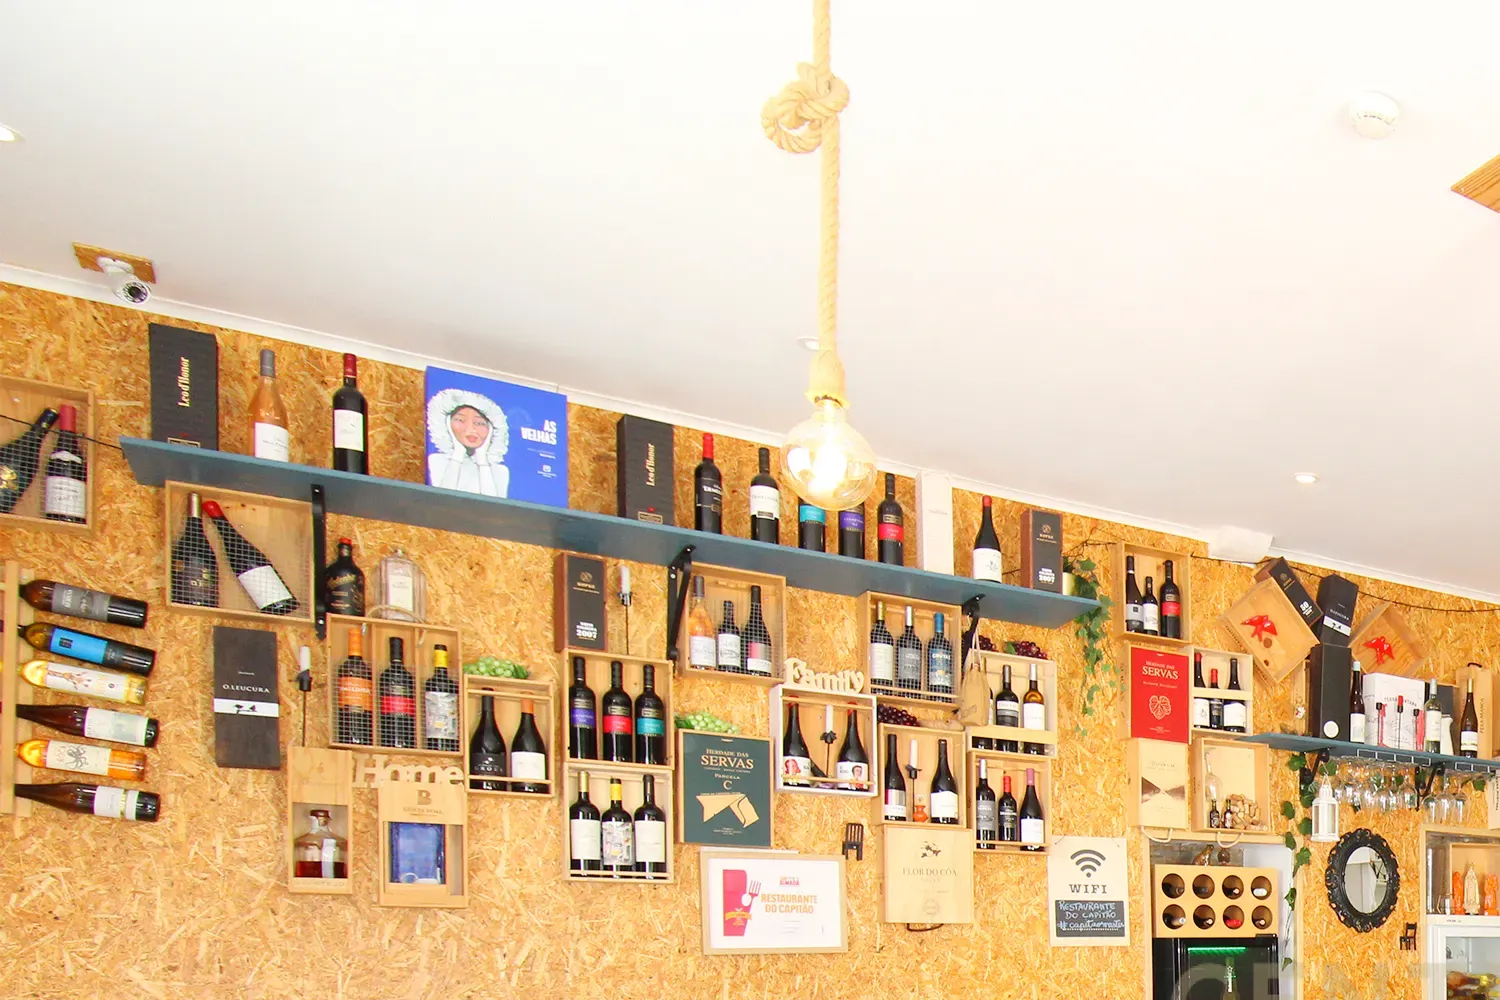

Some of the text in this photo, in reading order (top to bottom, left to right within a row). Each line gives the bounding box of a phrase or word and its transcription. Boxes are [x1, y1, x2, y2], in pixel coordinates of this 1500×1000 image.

[543, 419, 557, 433] AS
[520, 427, 557, 446] VELHAS
[1038, 574, 1055, 583] 2007
[576, 629, 598, 639] 2007
[784, 657, 864, 695] Family
[1142, 665, 1179, 680] SERVAS
[222, 683, 270, 694] O.LEUCURA
[706, 748, 735, 757] HERDADE
[700, 754, 755, 770] SERVAS
[353, 754, 464, 789] Home
[723, 780, 733, 790] C
[902, 867, 958, 877] FLOR DO CÔA
[1069, 883, 1108, 894] WIFI
[761, 893, 818, 904] RESTAURANTE
[765, 903, 814, 914] DO CAPITÃO
[1058, 900, 1116, 911] RESTAURANTE
[1065, 911, 1079, 920] DO
